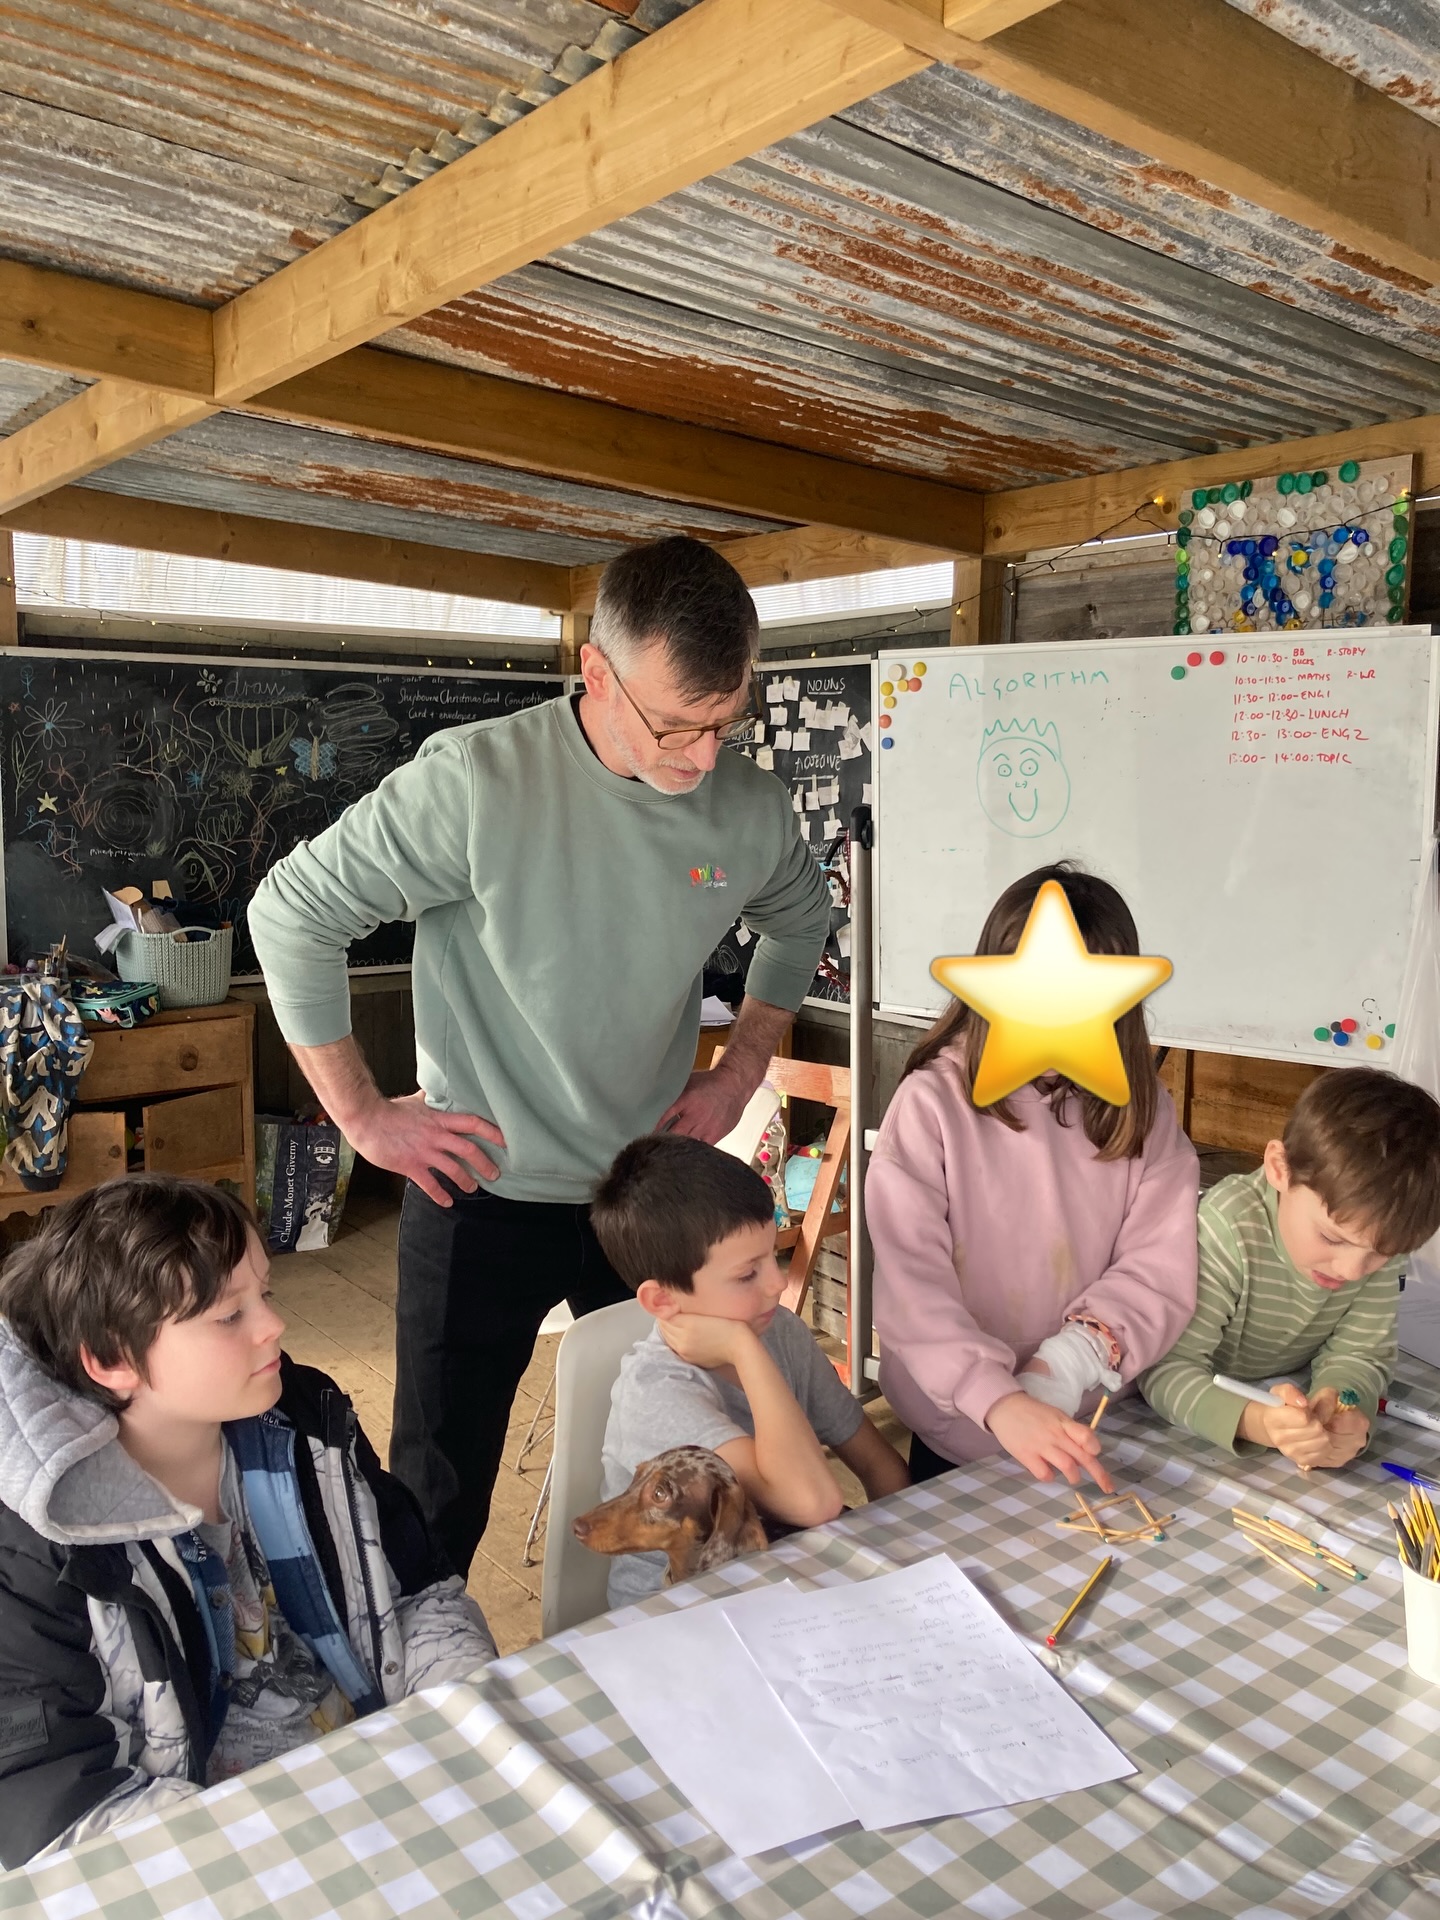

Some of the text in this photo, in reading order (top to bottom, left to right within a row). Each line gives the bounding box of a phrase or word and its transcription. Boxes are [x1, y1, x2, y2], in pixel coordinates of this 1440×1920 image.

[225, 672, 285, 697] draw
[807, 677, 846, 693] NOUNS
[1297, 673, 1331, 681] MATHS
[950, 671, 1109, 700] ALGORITHM
[440, 688, 482, 704] Christmas
[482, 690, 500, 704] Card
[504, 690, 550, 708] Competitio
[408, 707, 427, 719] Card
[1308, 709, 1349, 720] LUNCH
[1317, 753, 1352, 764] TOPIC
[280, 1139, 299, 1243] Claude Monet Giverny
